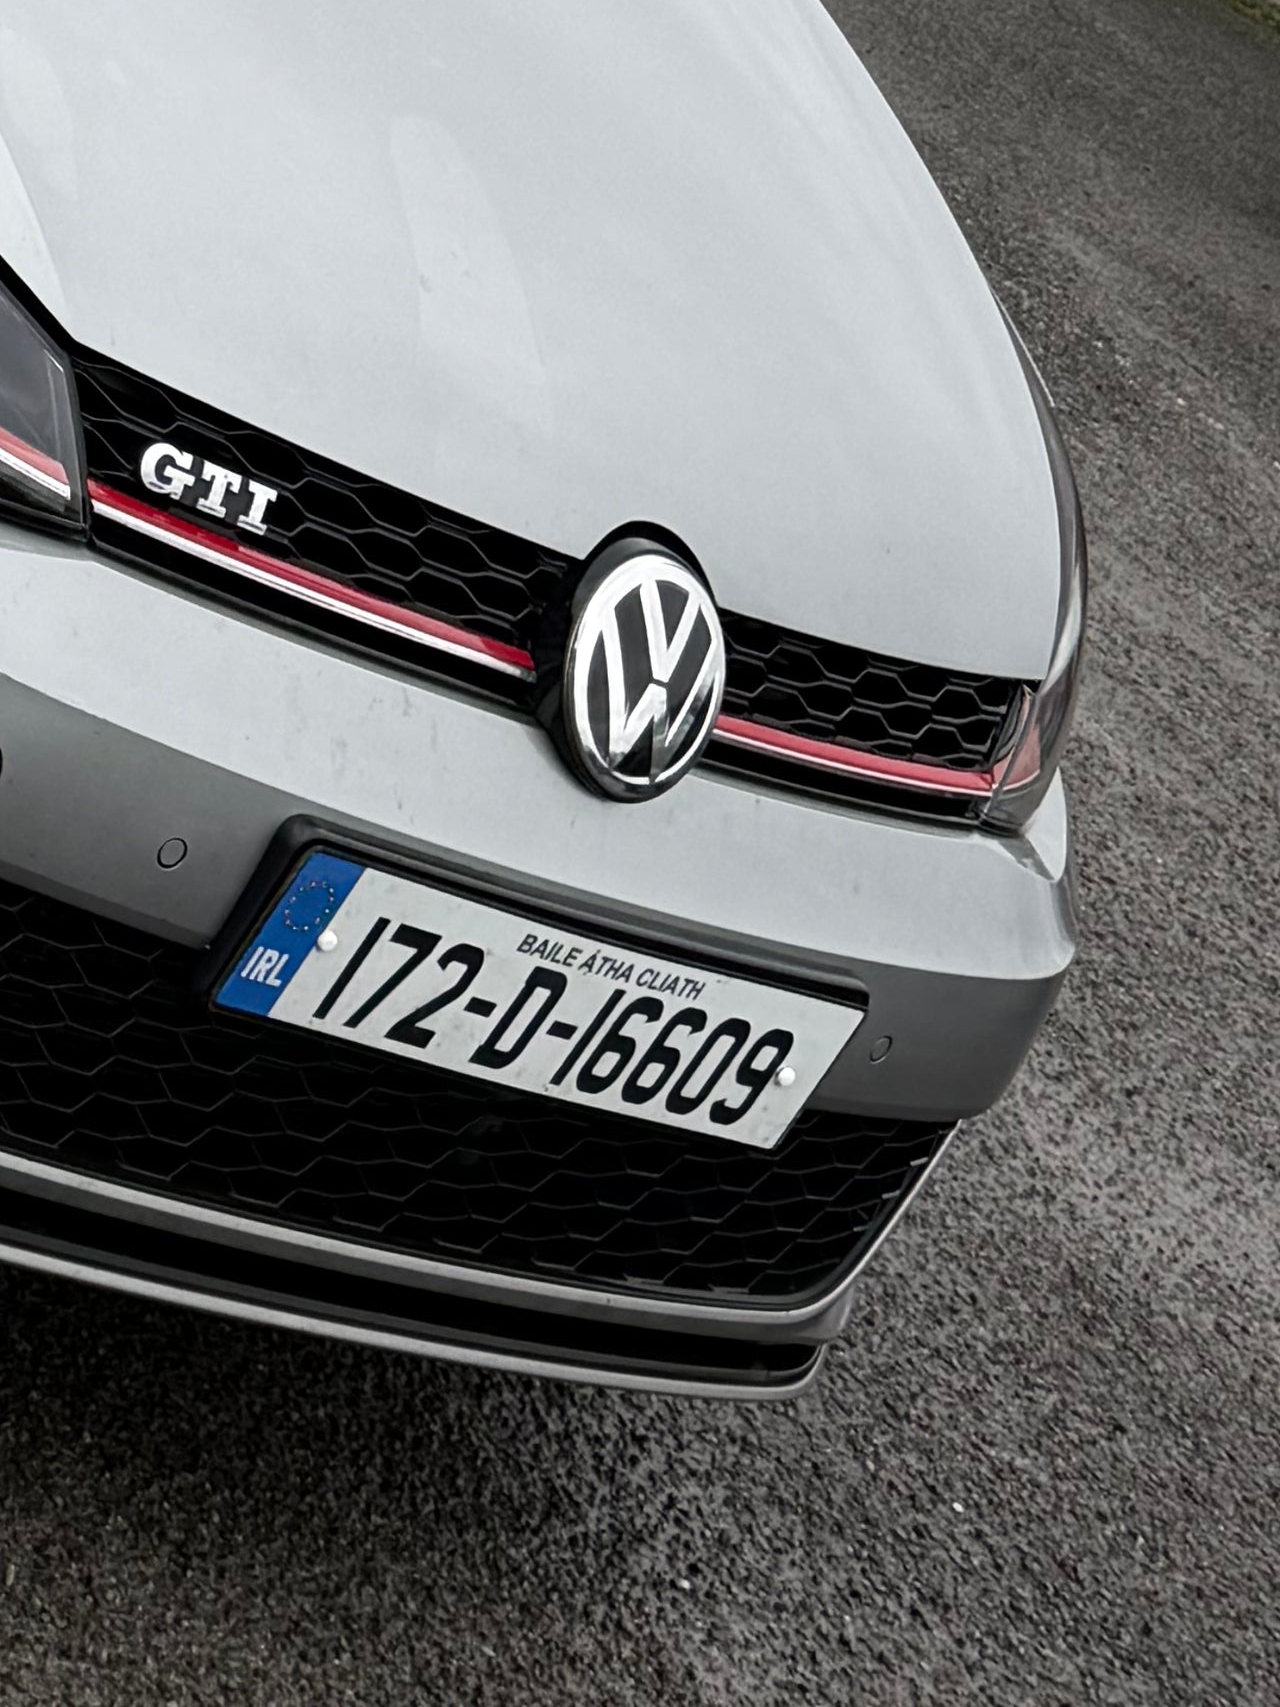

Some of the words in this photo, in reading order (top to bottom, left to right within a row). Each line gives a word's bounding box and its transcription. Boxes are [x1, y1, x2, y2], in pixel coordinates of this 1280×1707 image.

[140, 441, 278, 536] GTI
[240, 945, 286, 989] IRL
[515, 932, 583, 969] BAILE
[577, 946, 634, 986] ÁTHA
[633, 966, 707, 1001] CLIATH
[312, 916, 794, 1127] 172-D-16609
